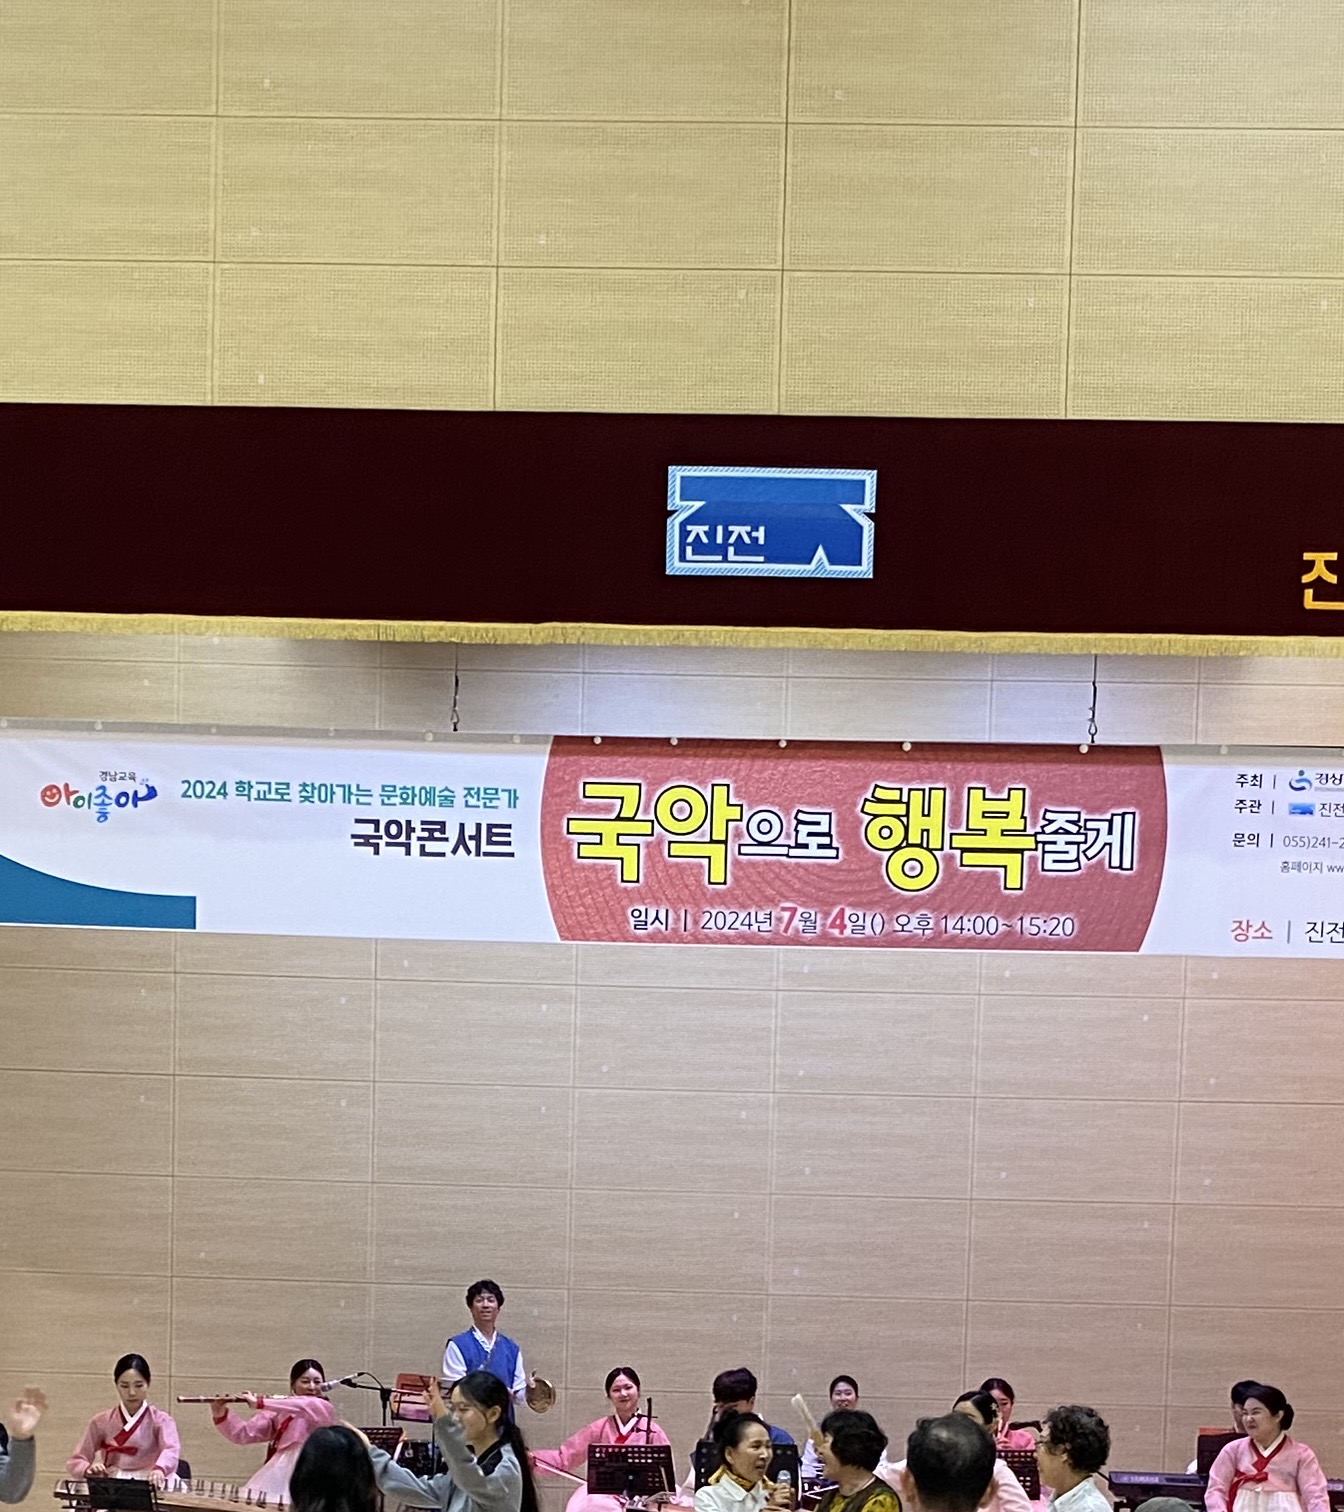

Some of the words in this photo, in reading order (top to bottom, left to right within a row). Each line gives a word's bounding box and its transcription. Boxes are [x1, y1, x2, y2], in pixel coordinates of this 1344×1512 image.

[685, 524, 765, 562] 진전
[99, 770, 137, 782] 경남교육
[1236, 774, 1263, 789] 주최
[40, 783, 158, 823] 아이좋아
[181, 780, 228, 800] 2024
[234, 780, 292, 803] 학교로
[298, 782, 373, 806] 찾아가는
[379, 784, 456, 809] 문화예술
[463, 786, 519, 809] 전문가
[1234, 799, 1262, 814] 주관
[350, 818, 516, 858] 국악콘서트
[566, 781, 840, 885] 국악으로
[859, 783, 1136, 892] 행복줄게
[1232, 833, 1260, 848] 문의
[1280, 861, 1323, 874] 홈페이지
[630, 908, 670, 932] 일시
[700, 909, 774, 934] 2024년
[779, 906, 819, 935] 7월
[892, 912, 934, 935] 오후
[940, 914, 1075, 938] 14:00~15:20
[1231, 919, 1273, 943] 장소
